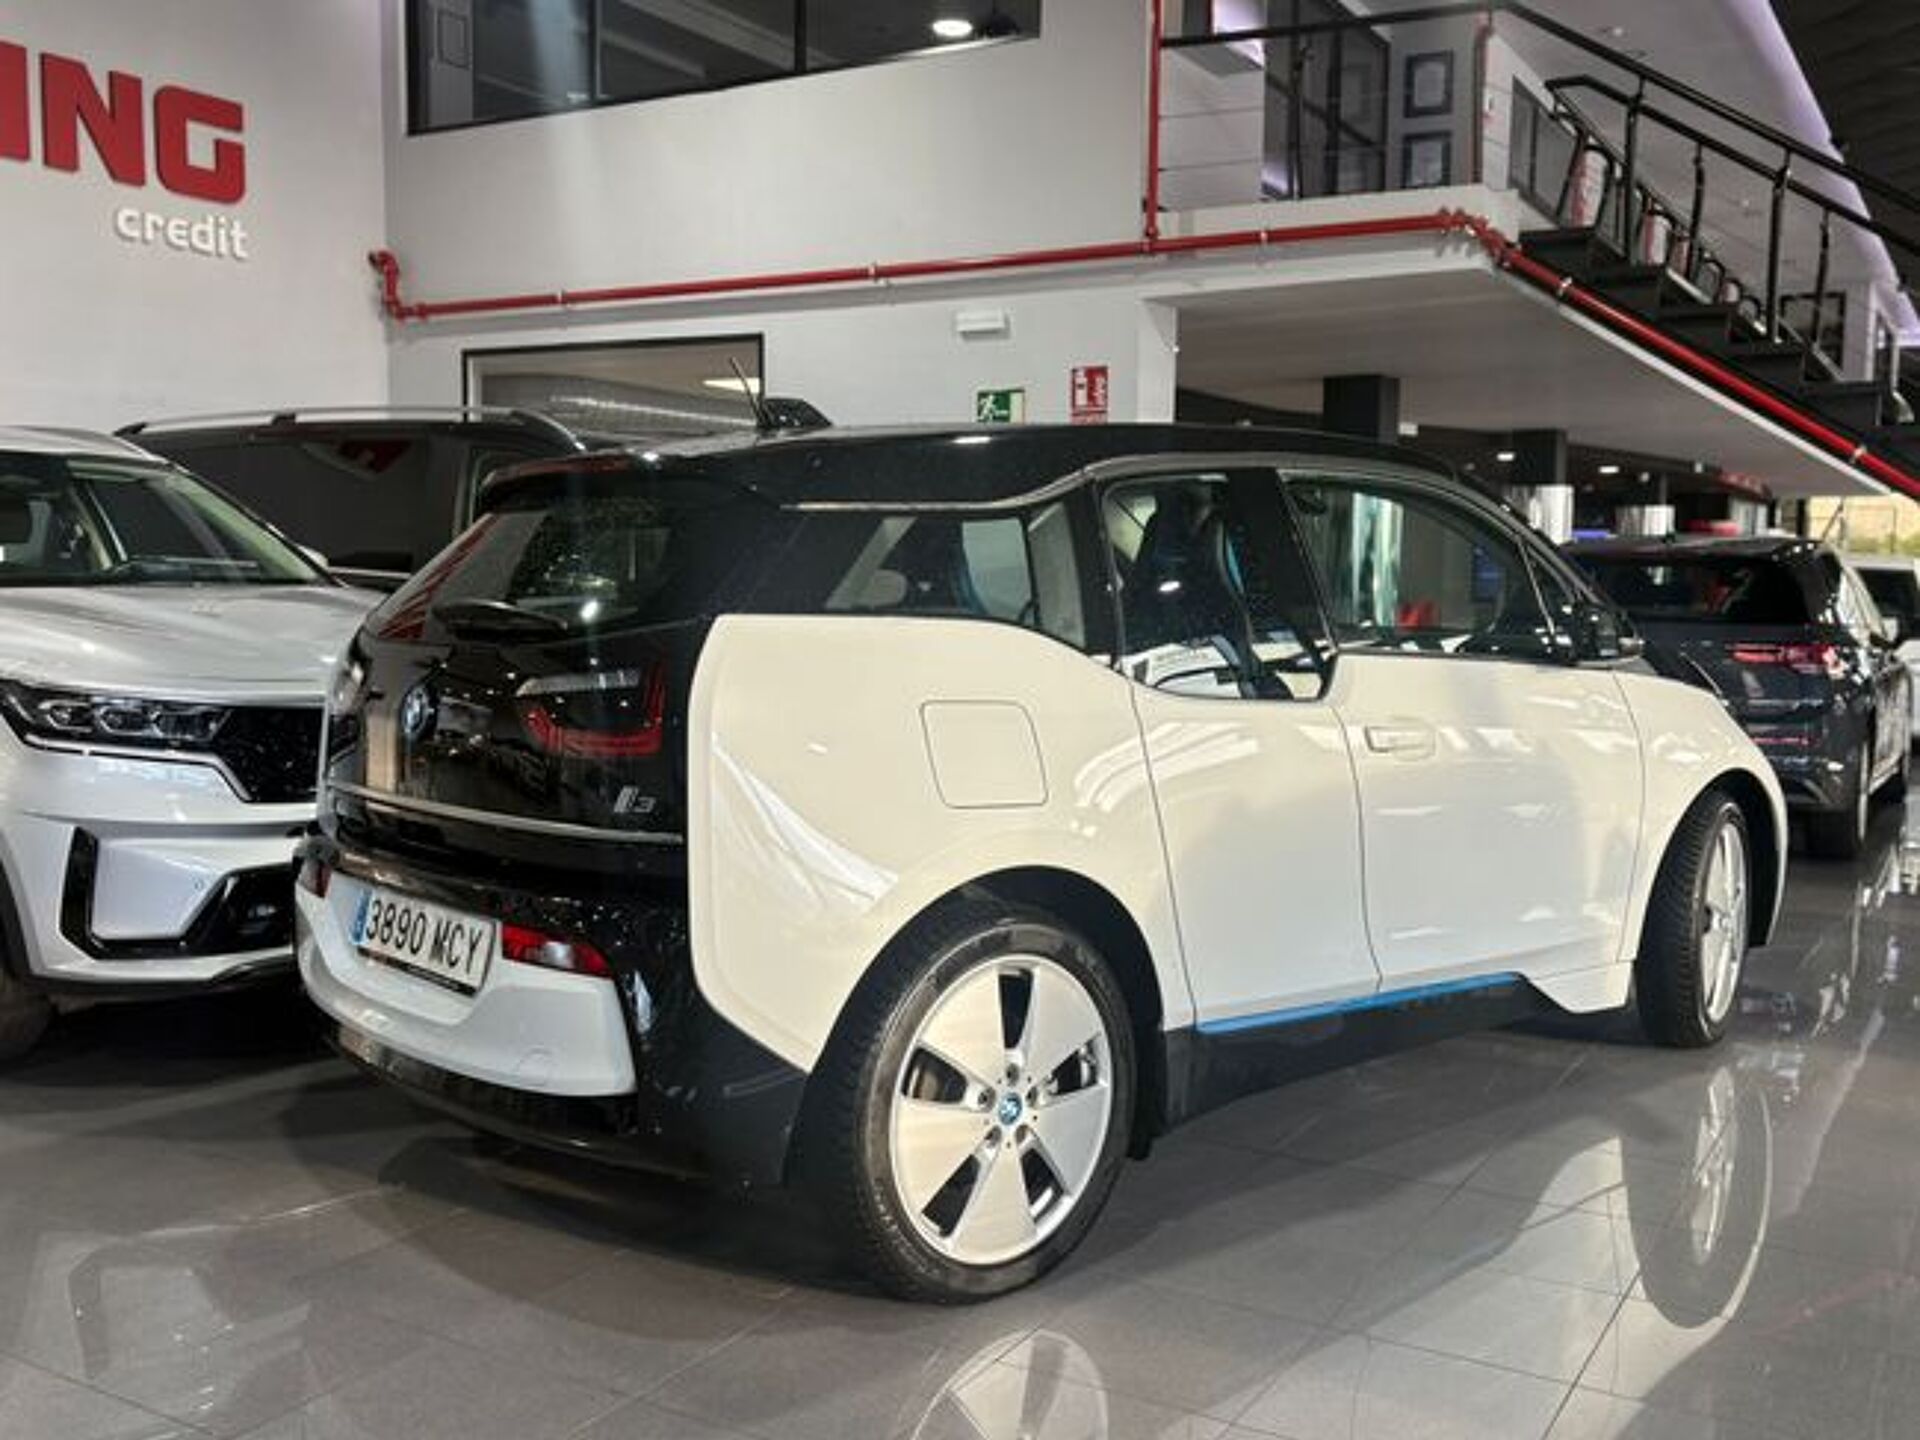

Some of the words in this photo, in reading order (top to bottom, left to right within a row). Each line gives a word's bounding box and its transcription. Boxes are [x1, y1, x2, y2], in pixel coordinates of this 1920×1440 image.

[115, 207, 249, 260] credit
[366, 899, 427, 955] 3890
[429, 917, 482, 975] MCY
